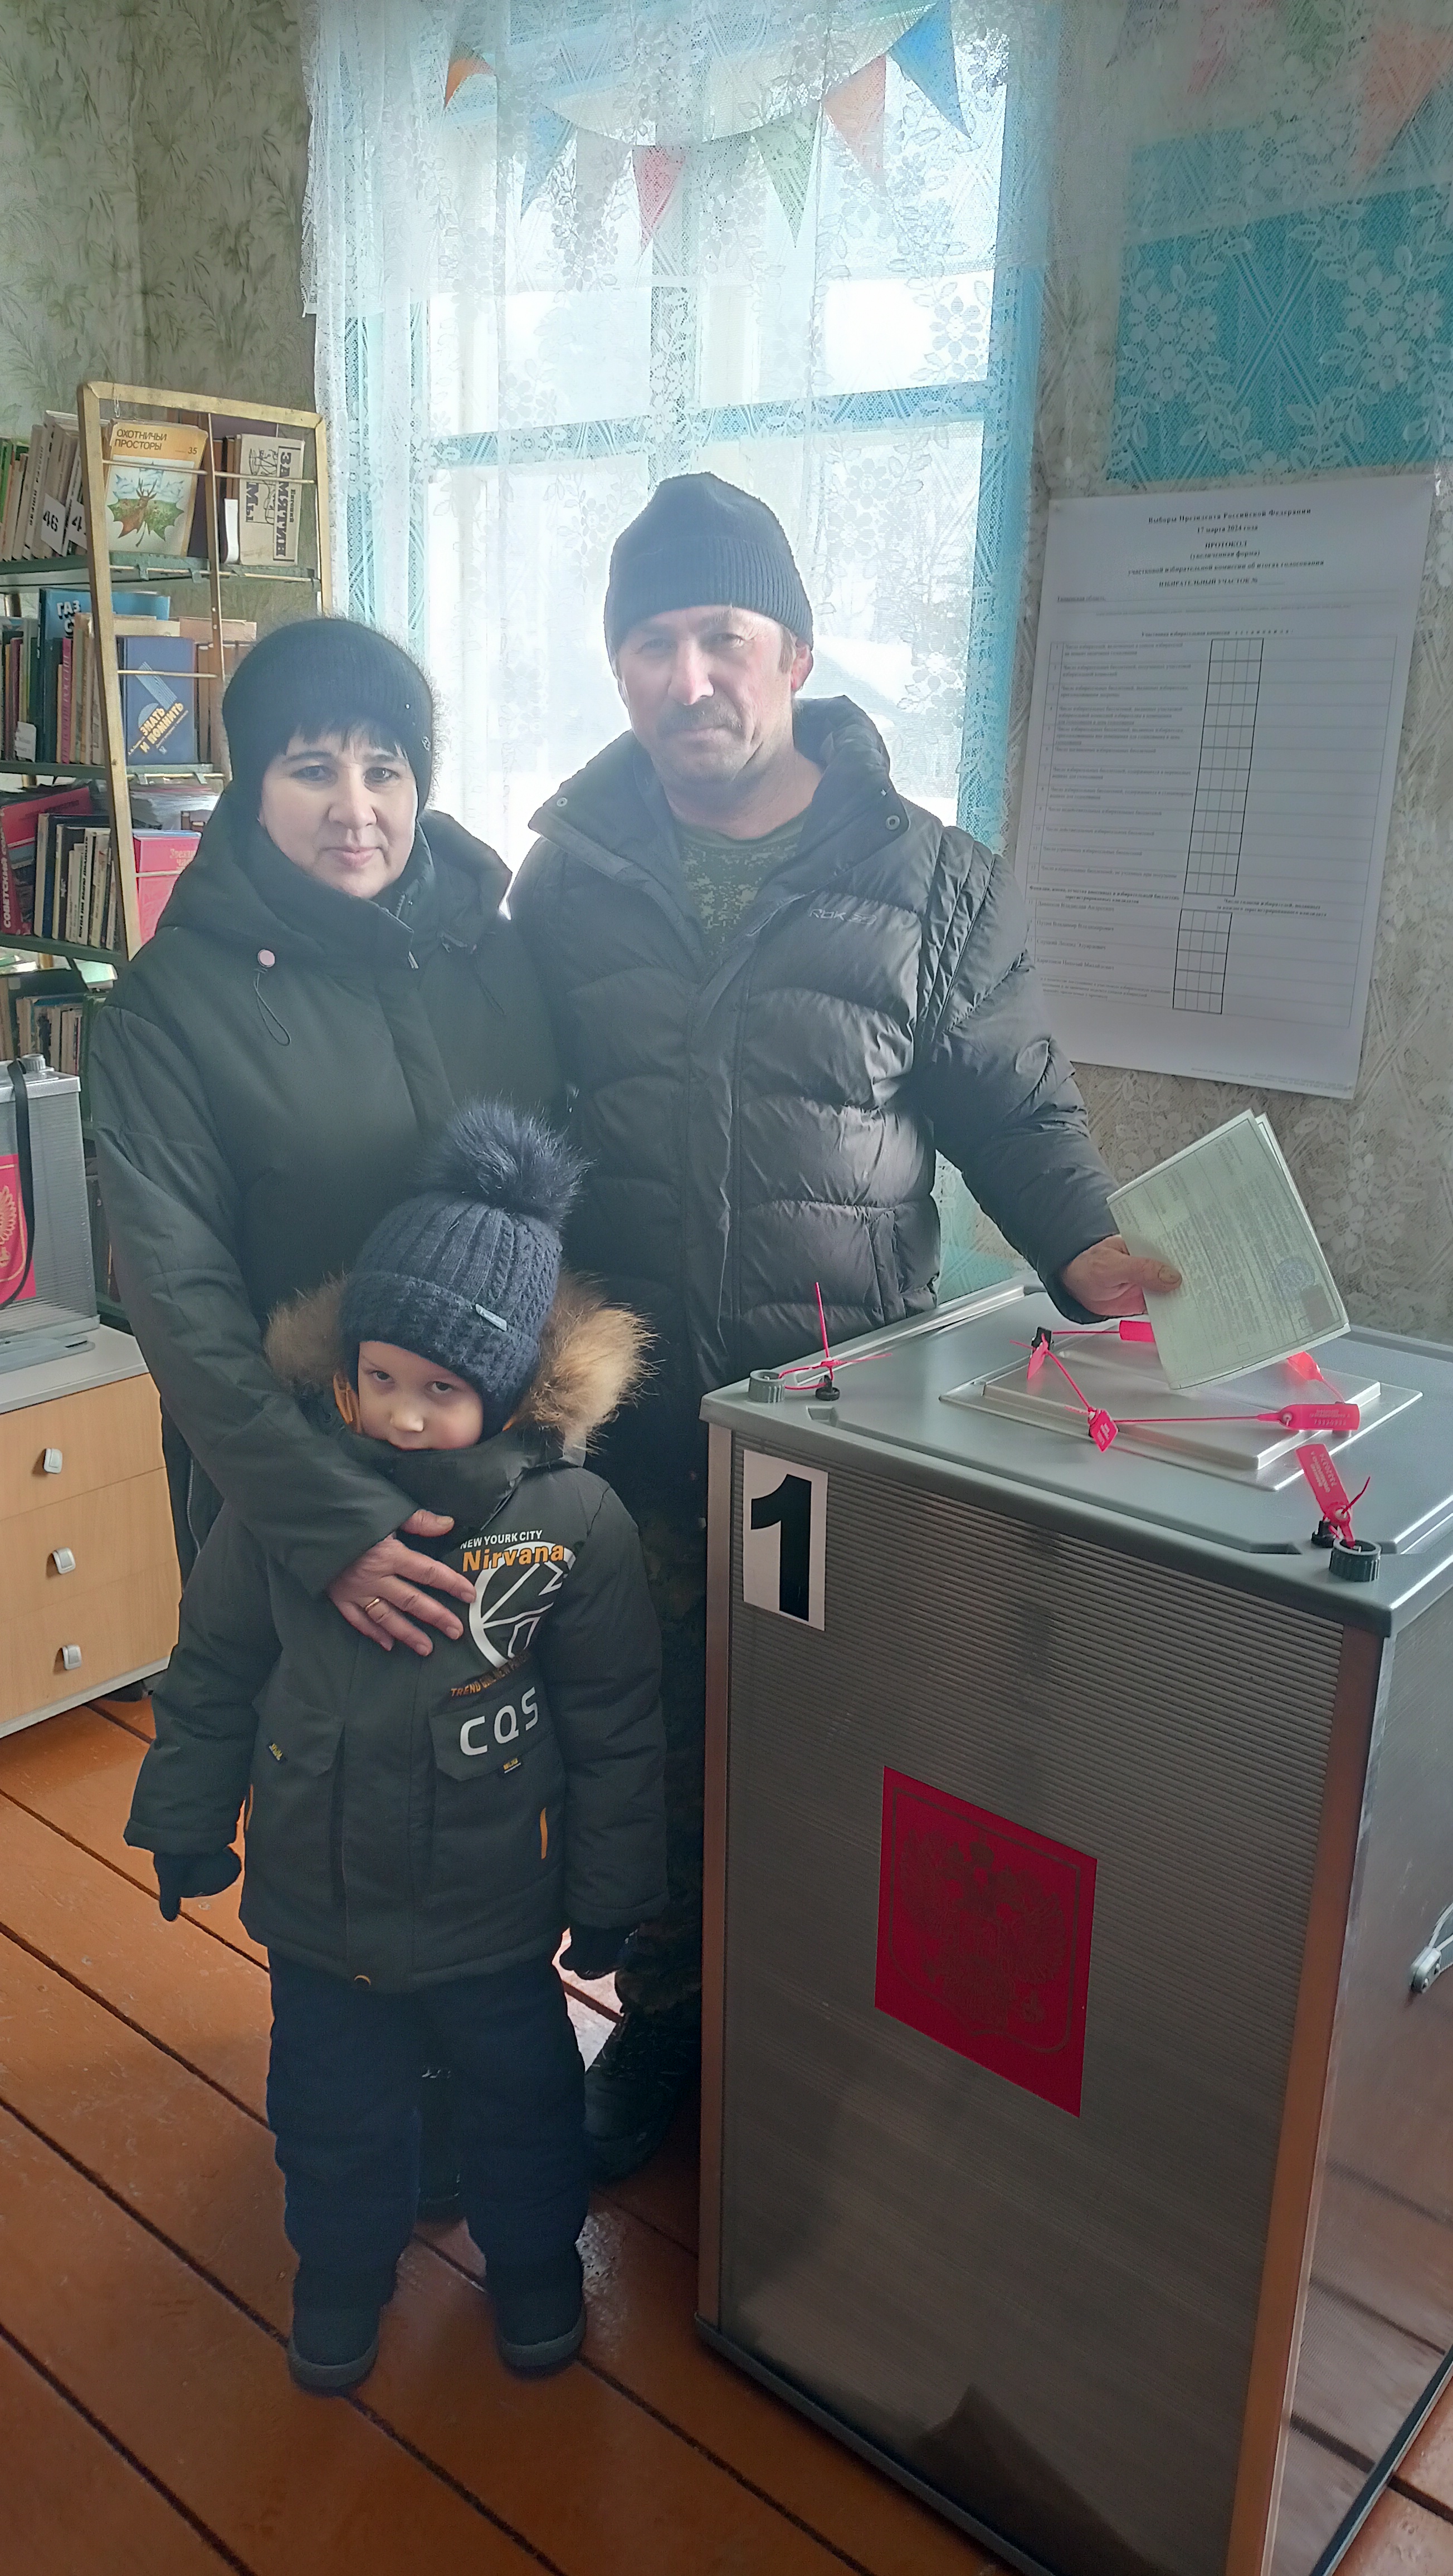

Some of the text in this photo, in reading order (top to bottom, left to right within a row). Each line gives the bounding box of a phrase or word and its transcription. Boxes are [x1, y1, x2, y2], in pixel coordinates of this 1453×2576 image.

[114, 439, 162, 450] ПРОСТОРЫ
[116, 428, 167, 441] ОХОТНИЧЬИ
[72, 515, 86, 535] 4
[1148, 516, 1177, 525] Выборы
[1223, 509, 1266, 520] Российской
[1206, 526, 1226, 534] марта
[56, 599, 81, 618] ГАЗ
[139, 741, 151, 754] И
[147, 702, 184, 745] ПОМНИТЬ
[140, 708, 165, 736] ЗНАТЬ
[460, 1529, 543, 1549] NEW YOURK CITY
[750, 1474, 812, 1622] 1
[463, 1545, 564, 1572] Nirvana
[450, 1681, 481, 1697] TREND
[460, 1686, 538, 1756] CQS
